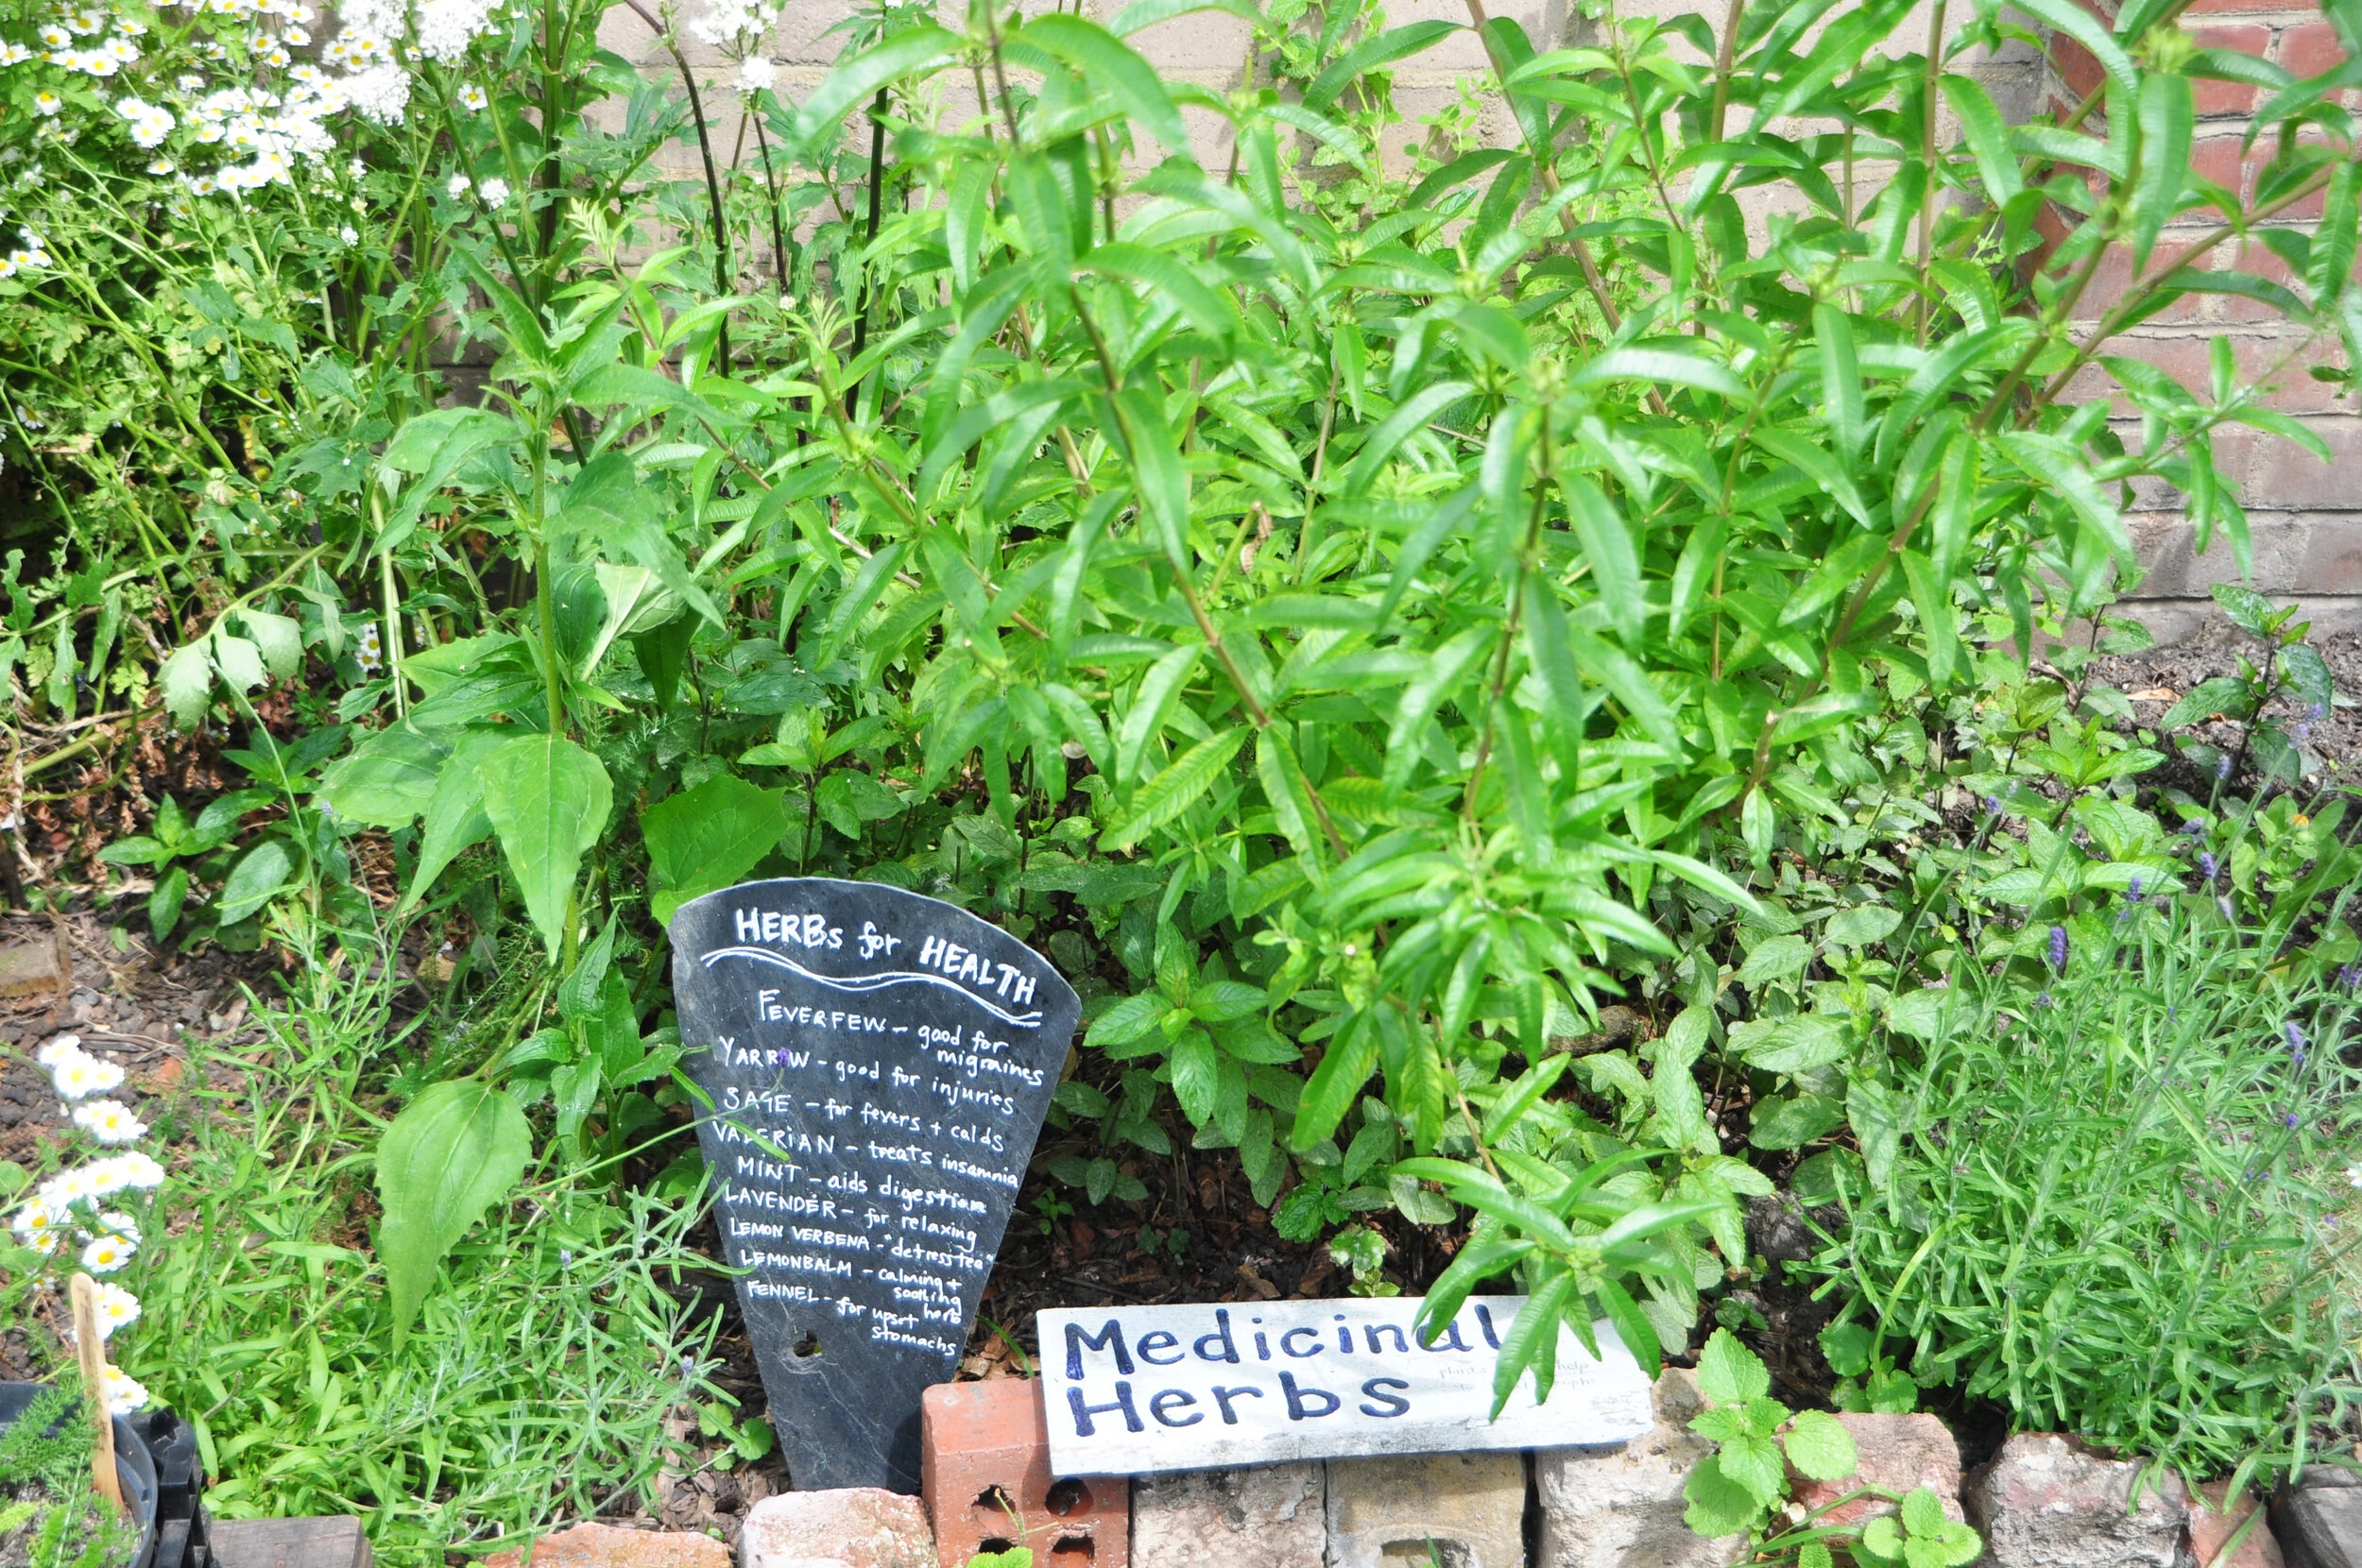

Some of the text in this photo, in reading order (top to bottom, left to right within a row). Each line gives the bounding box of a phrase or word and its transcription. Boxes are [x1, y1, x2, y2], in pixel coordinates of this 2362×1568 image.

[858, 921, 901, 960] for
[919, 935, 1037, 1005] HEALTH
[759, 989, 887, 1032] FEVERFEW
[971, 1031, 1009, 1053] for
[718, 1035, 811, 1067] YARRW
[835, 1060, 880, 1082] good
[892, 1065, 921, 1087] for
[932, 1077, 1014, 1115] injuries
[937, 1049, 1045, 1086] migraines
[824, 1098, 853, 1120] for
[860, 1101, 920, 1132] fevers
[867, 1140, 933, 1165] treats
[827, 1170, 869, 1194] aids
[725, 1184, 837, 1219] LAVENDER
[864, 1208, 890, 1229] for
[901, 1214, 977, 1253] relaxing
[730, 1217, 784, 1237] LEMON
[792, 1225, 870, 1252] VERBENA
[878, 1268, 943, 1295] calming
[746, 1279, 820, 1303] FENNEL
[835, 1296, 867, 1316] for
[872, 1307, 920, 1330] upset
[871, 1325, 957, 1356] stomachs
[1067, 1371, 1411, 1437] Herbs
